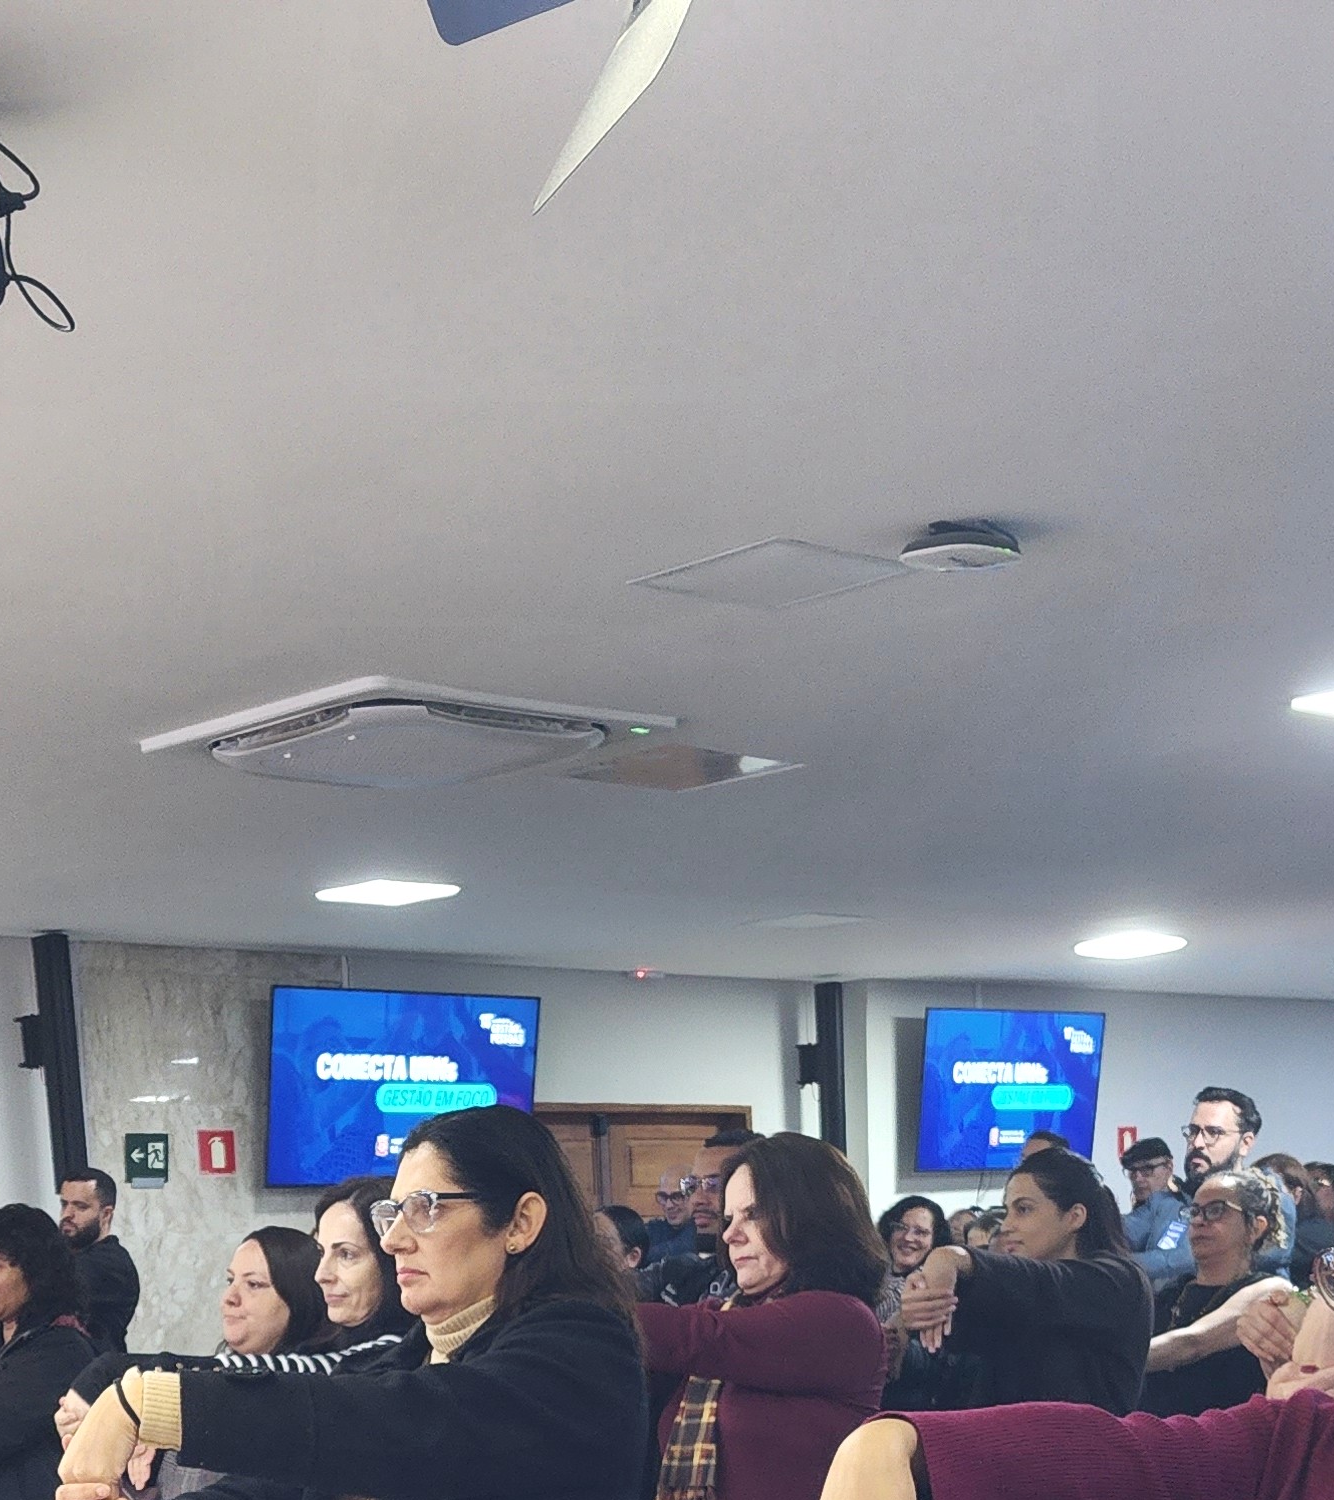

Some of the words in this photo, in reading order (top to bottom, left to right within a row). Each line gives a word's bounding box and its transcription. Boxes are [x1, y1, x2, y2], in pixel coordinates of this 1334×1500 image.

[317, 1053, 407, 1081] CONECTA
[953, 1061, 1013, 1084] CONECTA
[383, 1086, 433, 1107] GESTÃO
[434, 1089, 455, 1107] EM
[455, 1090, 490, 1107] FOCO
